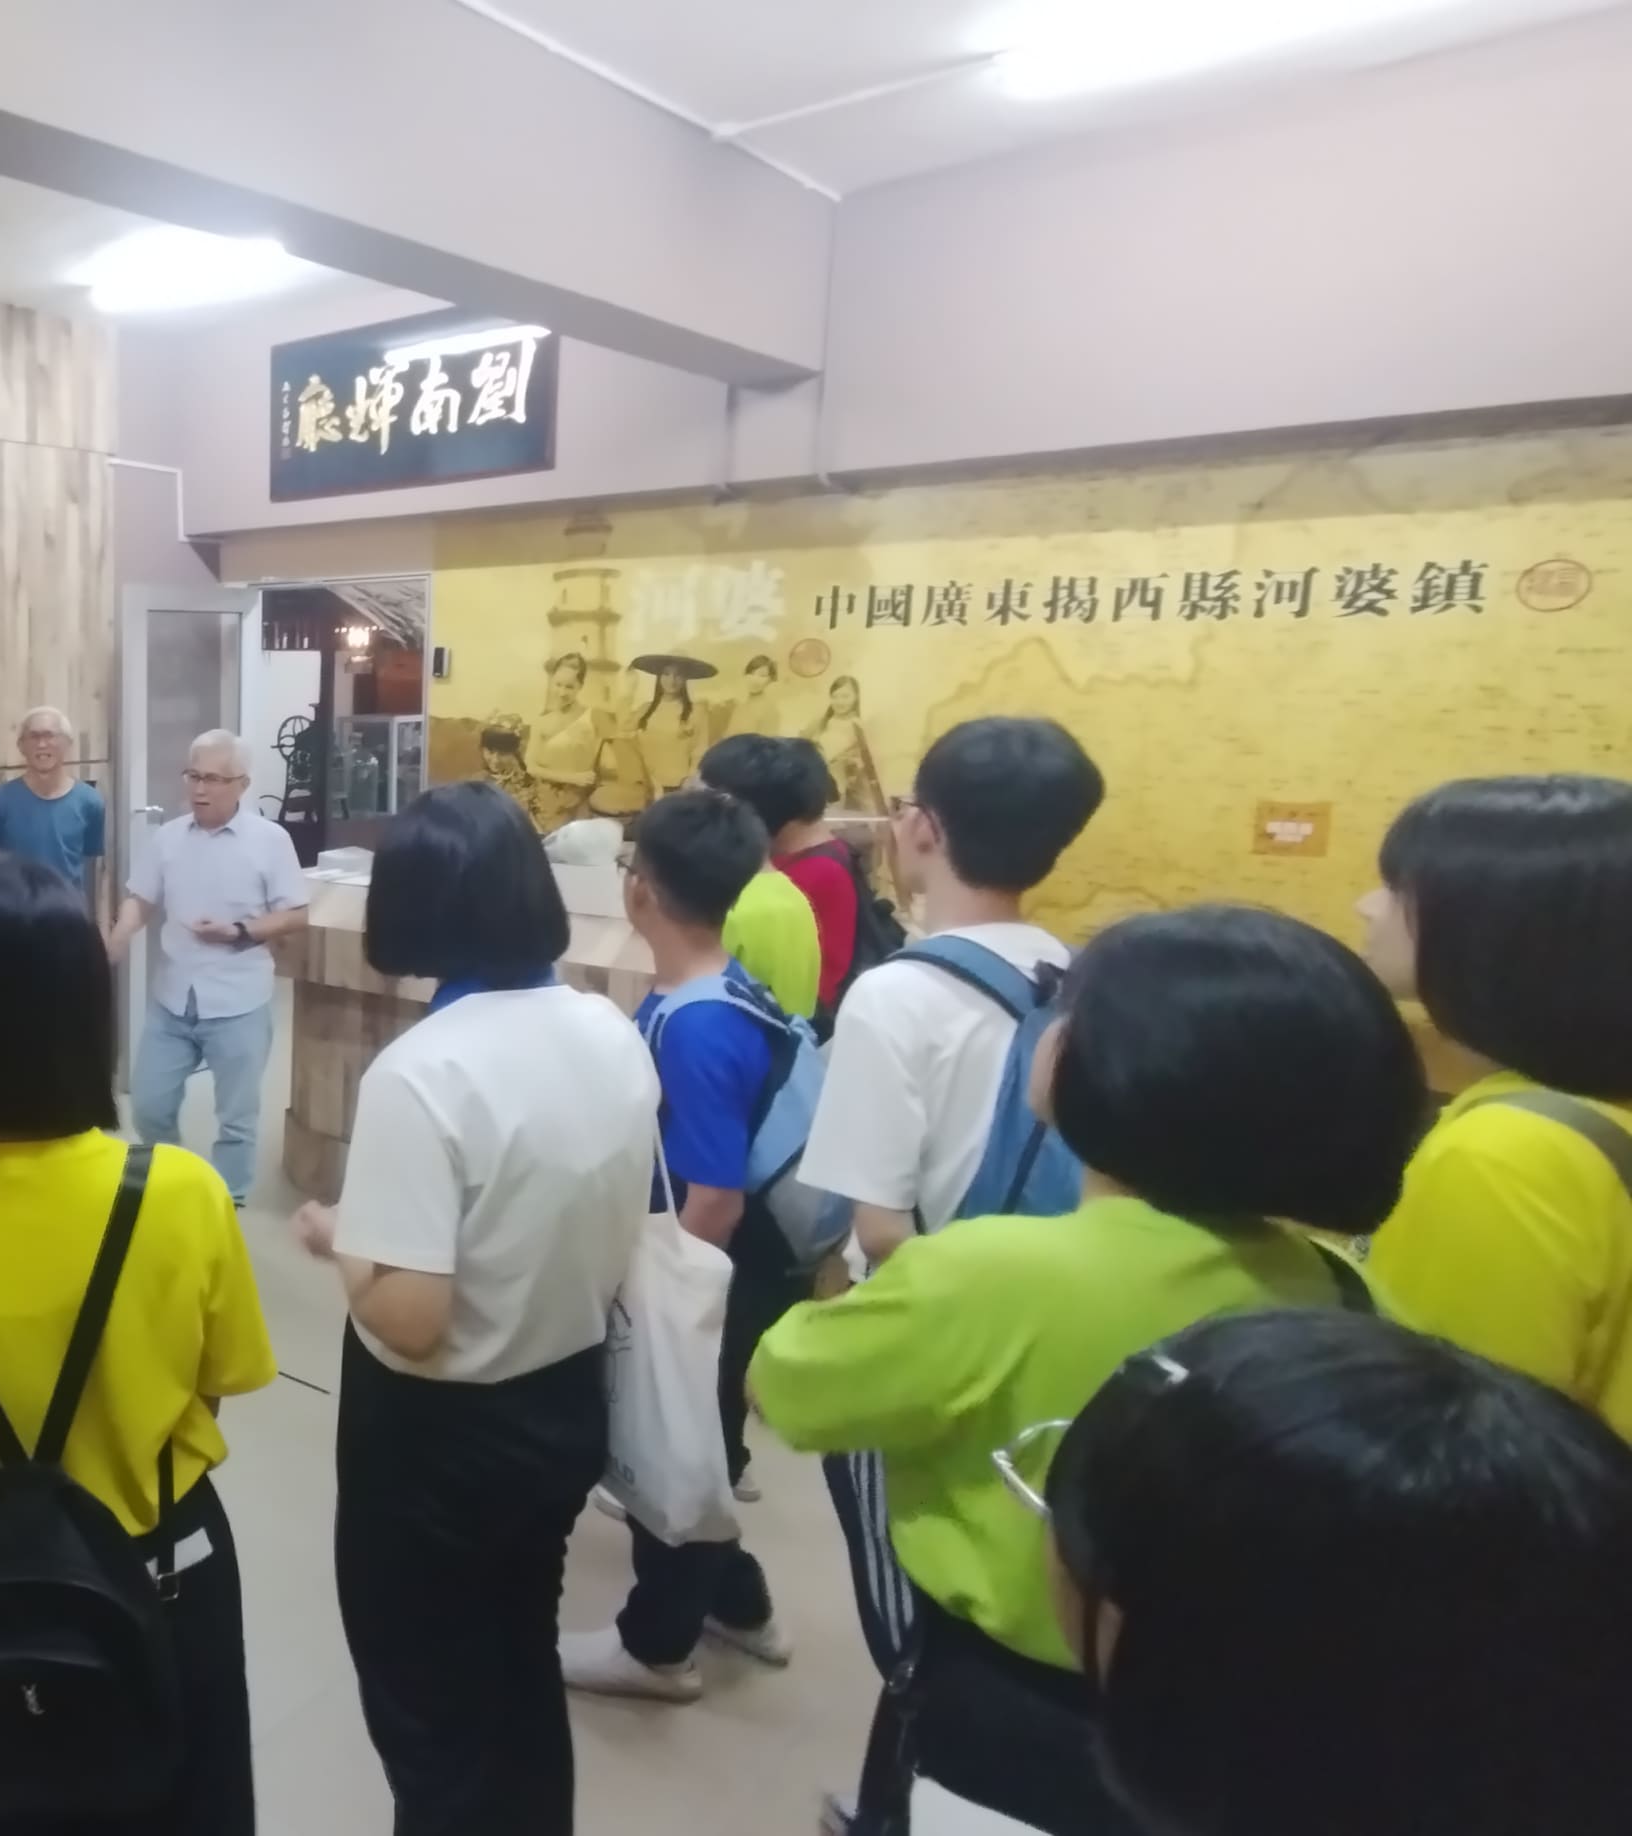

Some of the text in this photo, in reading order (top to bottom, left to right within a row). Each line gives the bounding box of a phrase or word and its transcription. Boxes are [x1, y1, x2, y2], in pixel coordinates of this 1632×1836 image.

[814, 559, 1490, 630] 中國廣東揭西縣河婆鎮
